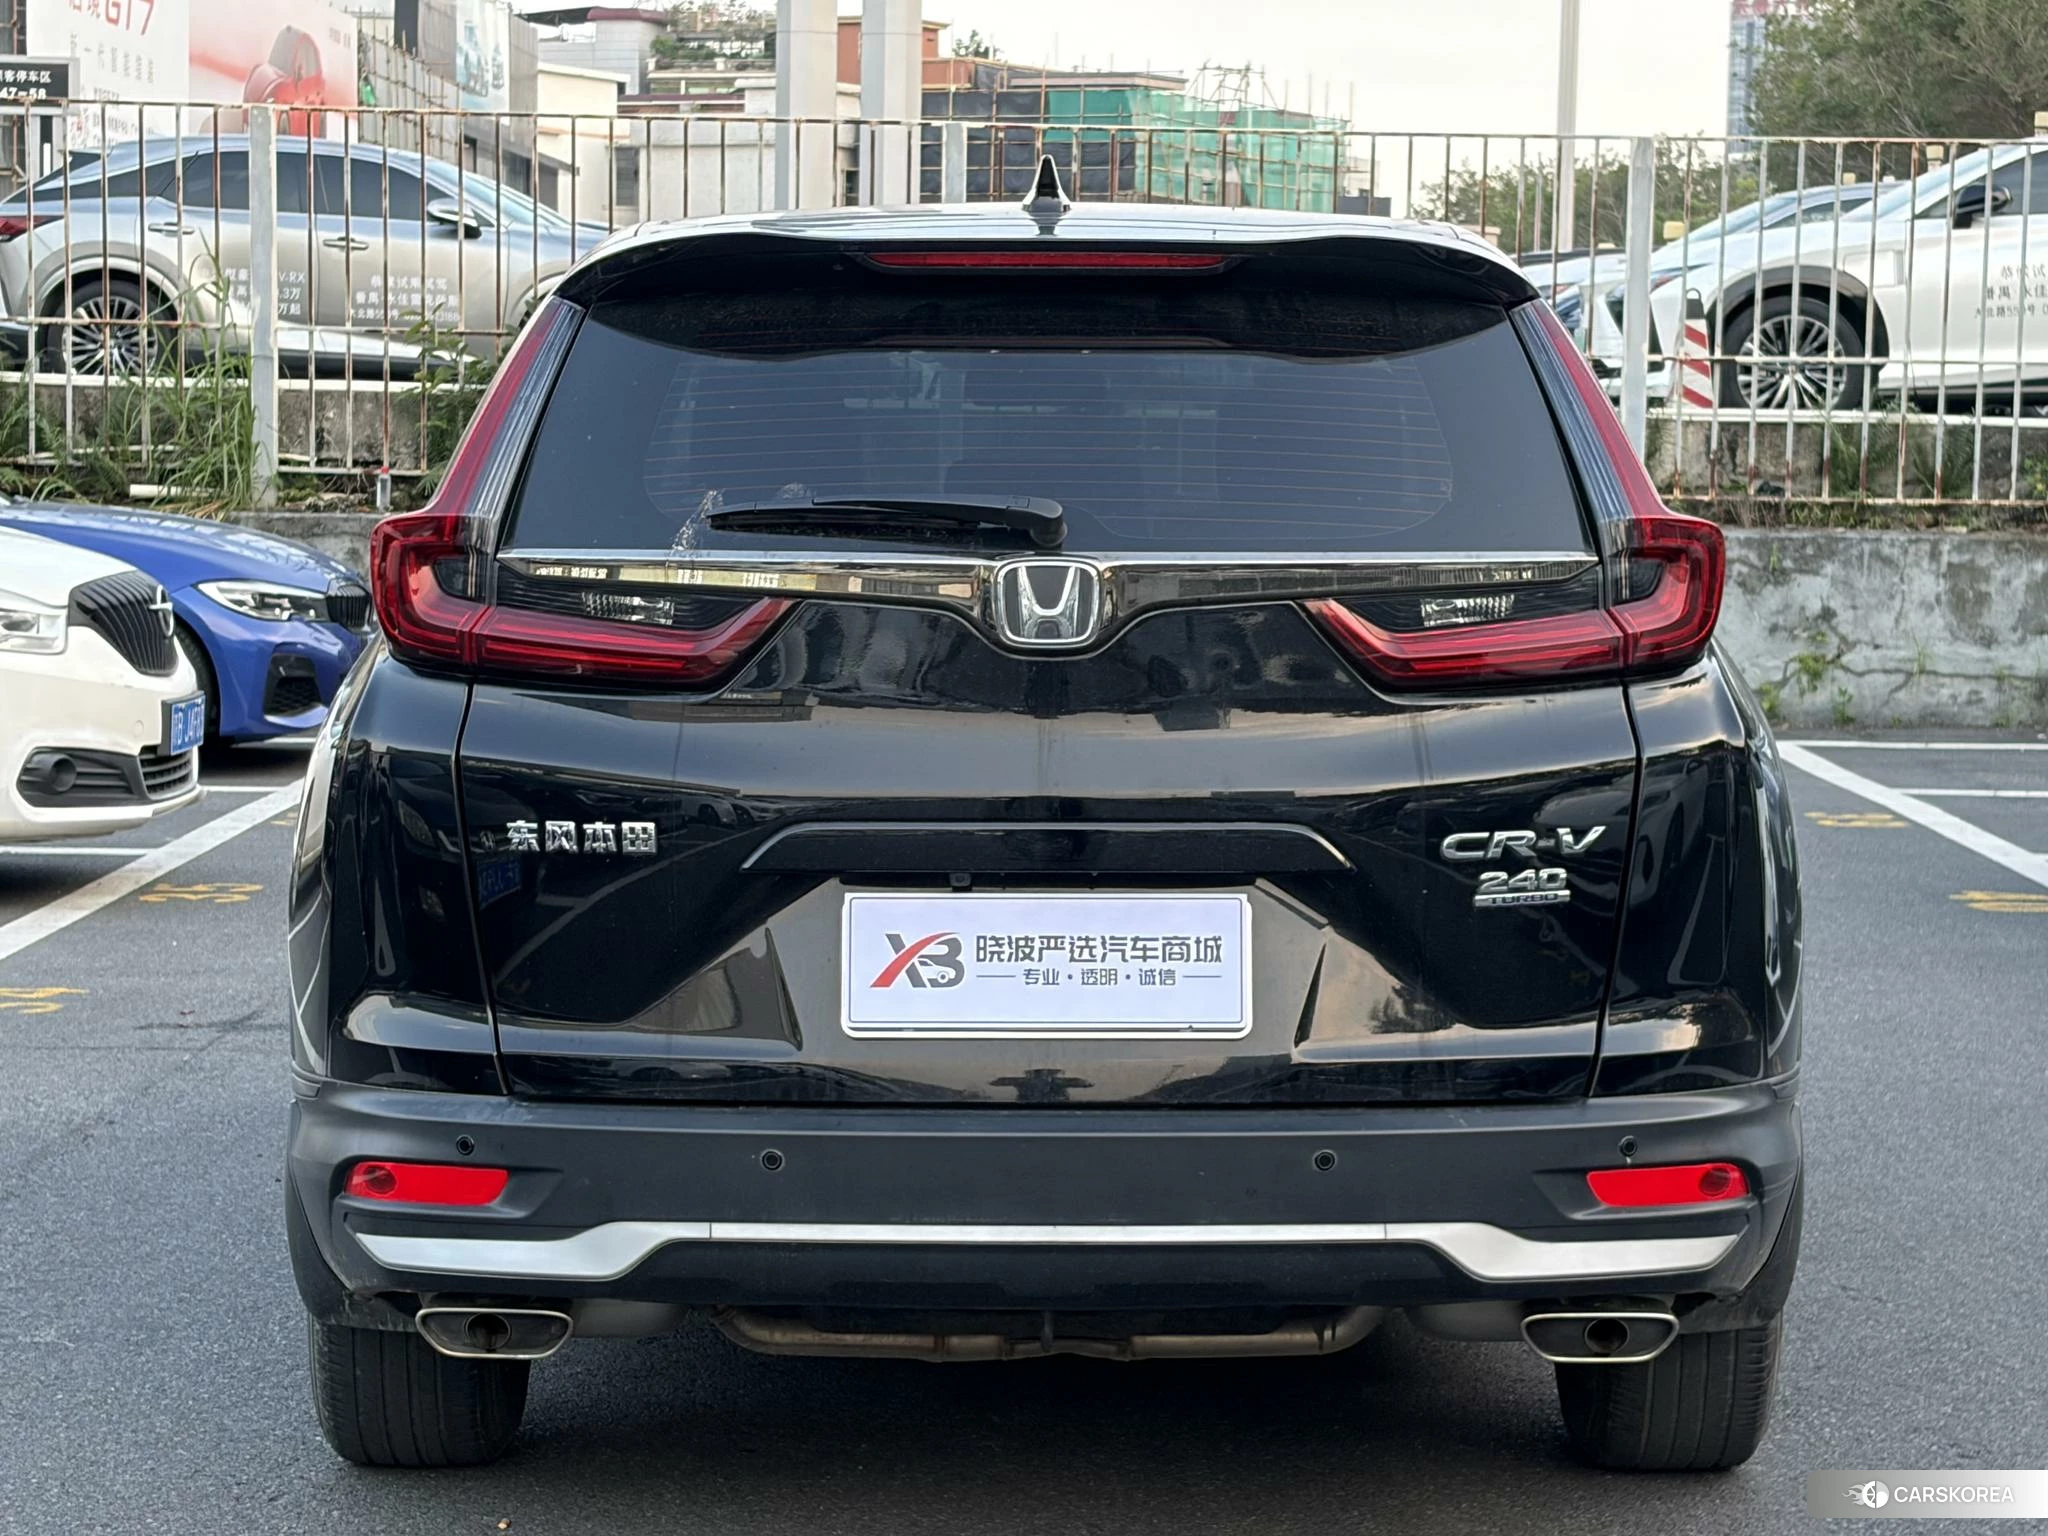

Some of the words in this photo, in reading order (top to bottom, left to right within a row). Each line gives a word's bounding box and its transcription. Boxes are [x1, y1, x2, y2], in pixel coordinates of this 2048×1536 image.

[506, 820, 659, 855] 东风本田
[1441, 825, 1606, 862] CR-V
[1477, 867, 1568, 894] 240
[1488, 893, 1560, 905] TURBO
[975, 934, 1223, 964] 晓波严选汽车商城
